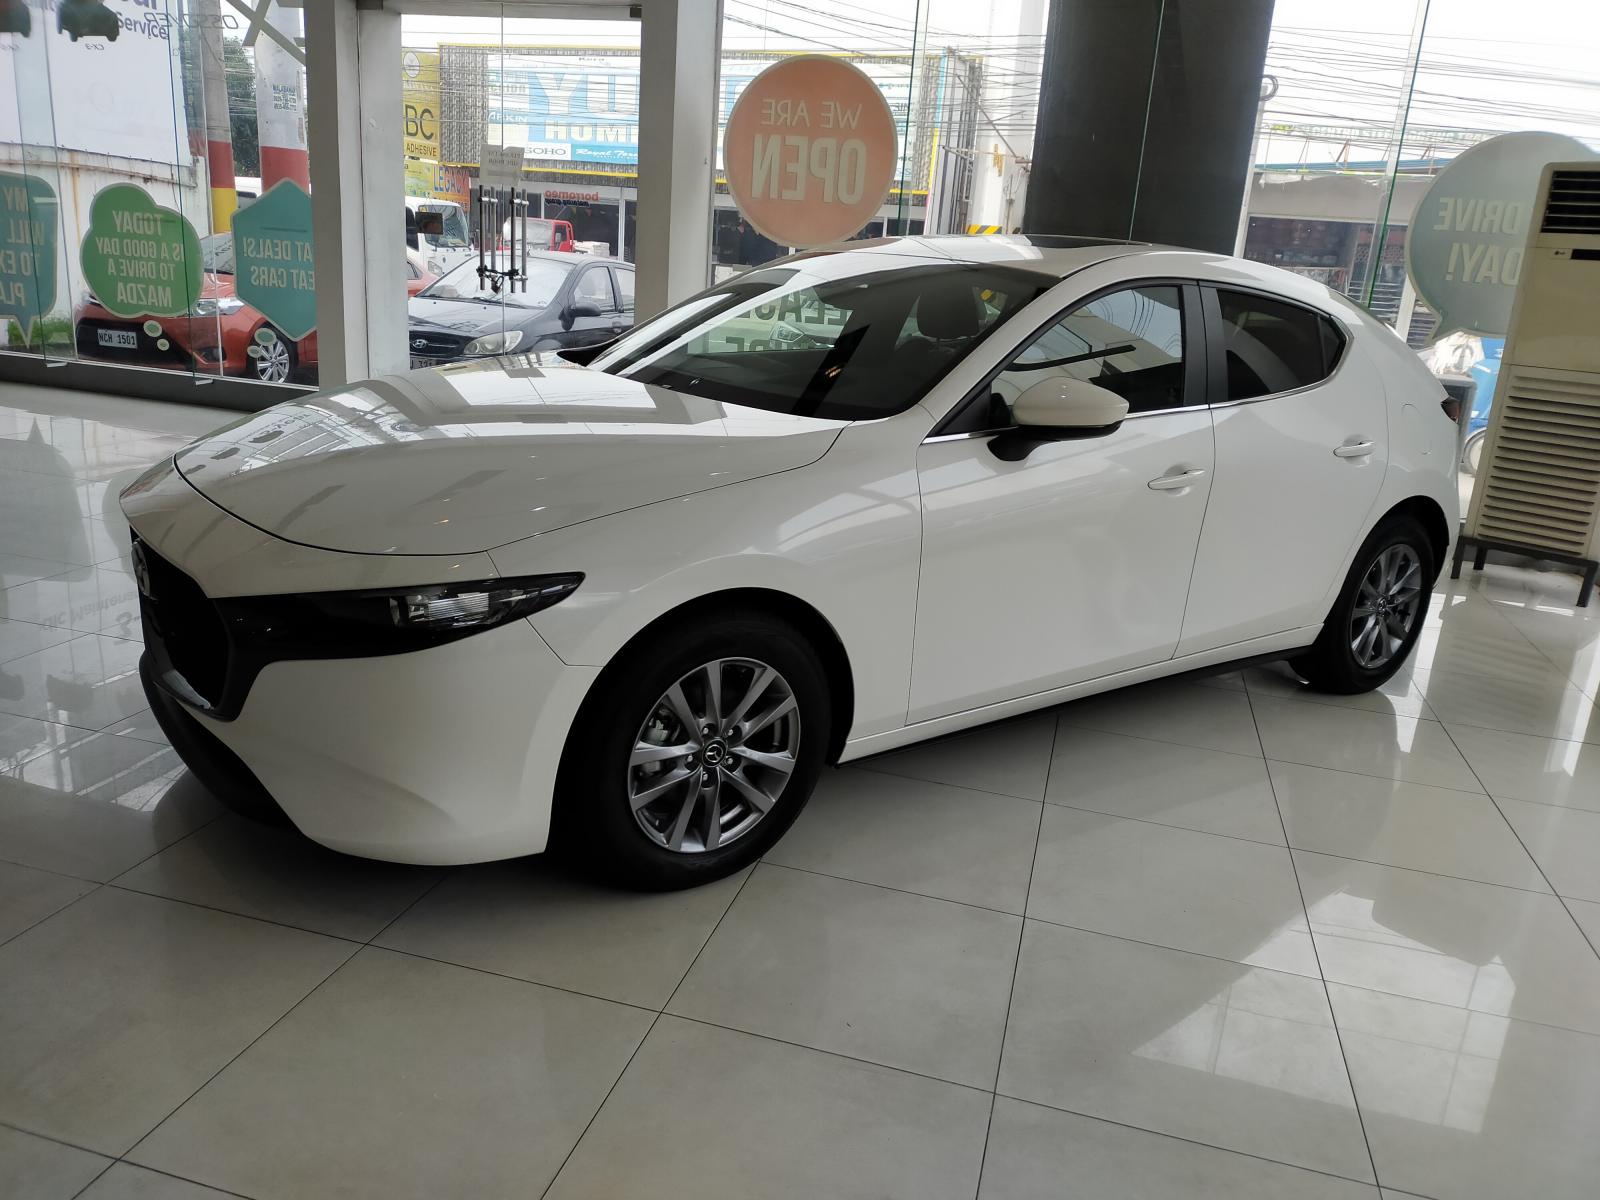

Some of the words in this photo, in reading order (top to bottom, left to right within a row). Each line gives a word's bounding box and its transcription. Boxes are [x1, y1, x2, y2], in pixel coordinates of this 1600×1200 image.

[403, 104, 434, 140] BC
[406, 143, 437, 157] ADHESIVE
[117, 334, 136, 346] 1501
